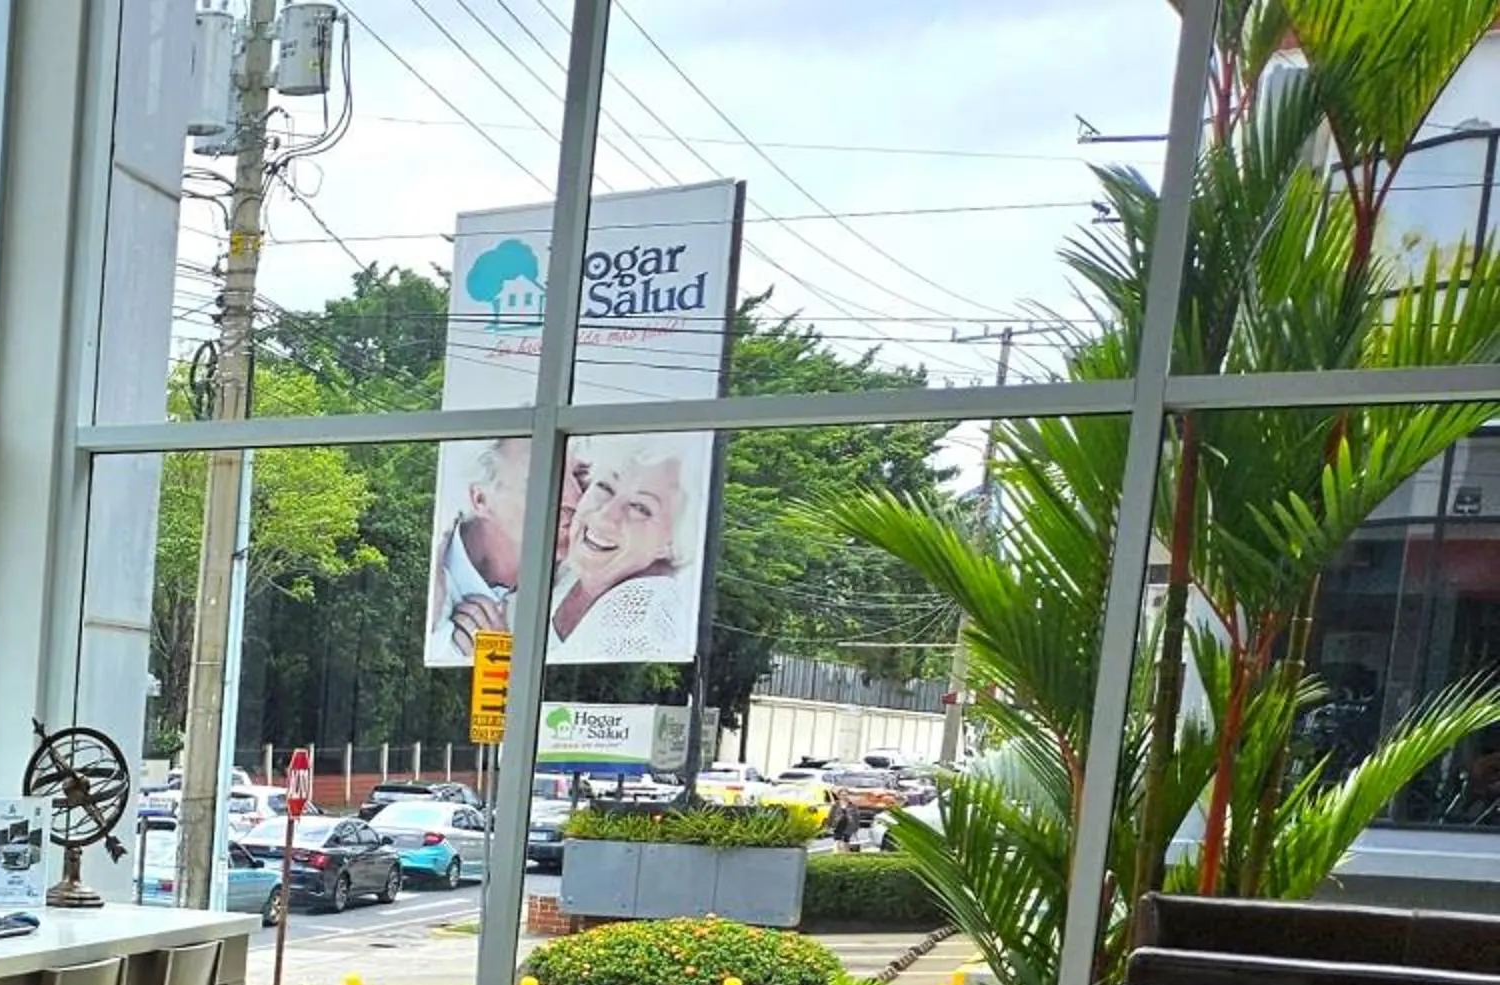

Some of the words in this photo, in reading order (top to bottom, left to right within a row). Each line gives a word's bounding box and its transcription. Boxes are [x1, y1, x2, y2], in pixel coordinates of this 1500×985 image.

[584, 244, 687, 288] ogar
[585, 271, 709, 319] Salud
[574, 711, 623, 728] Hogar
[587, 727, 630, 741] Salud
